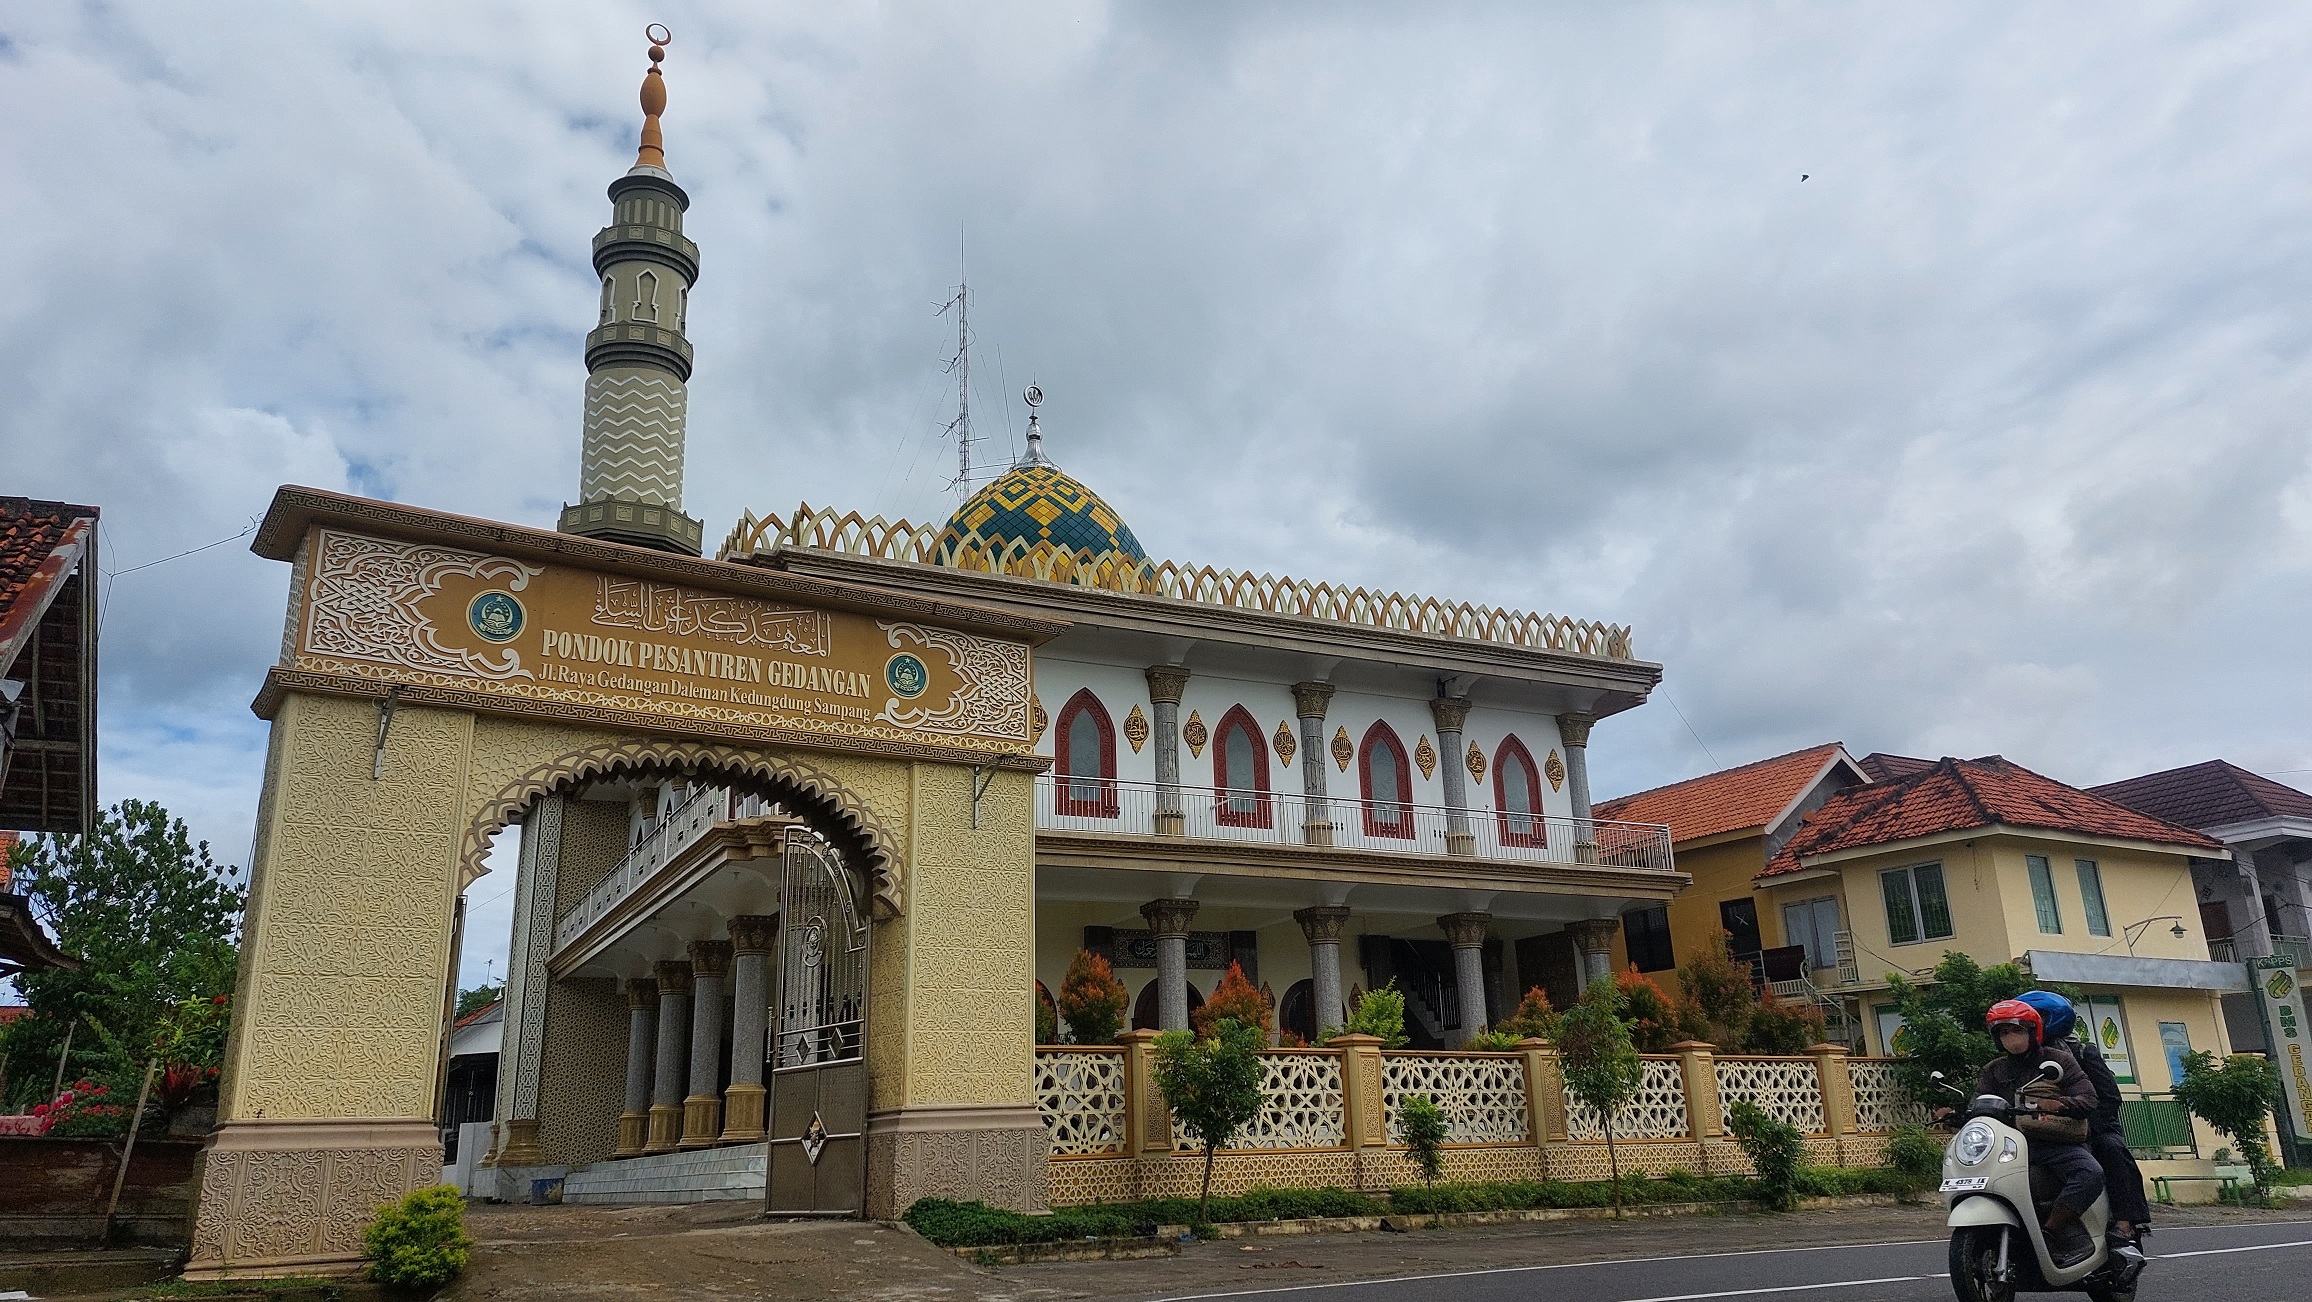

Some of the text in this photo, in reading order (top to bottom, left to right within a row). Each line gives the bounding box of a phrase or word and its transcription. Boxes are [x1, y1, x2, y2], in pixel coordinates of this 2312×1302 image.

[541, 629, 871, 699] PONDOK PESANTREN GEDANGAN
[597, 671, 669, 697] Gedangan
[670, 679, 728, 702] Daleman
[730, 687, 811, 715] Kedungdung
[813, 697, 870, 723] Sampang
